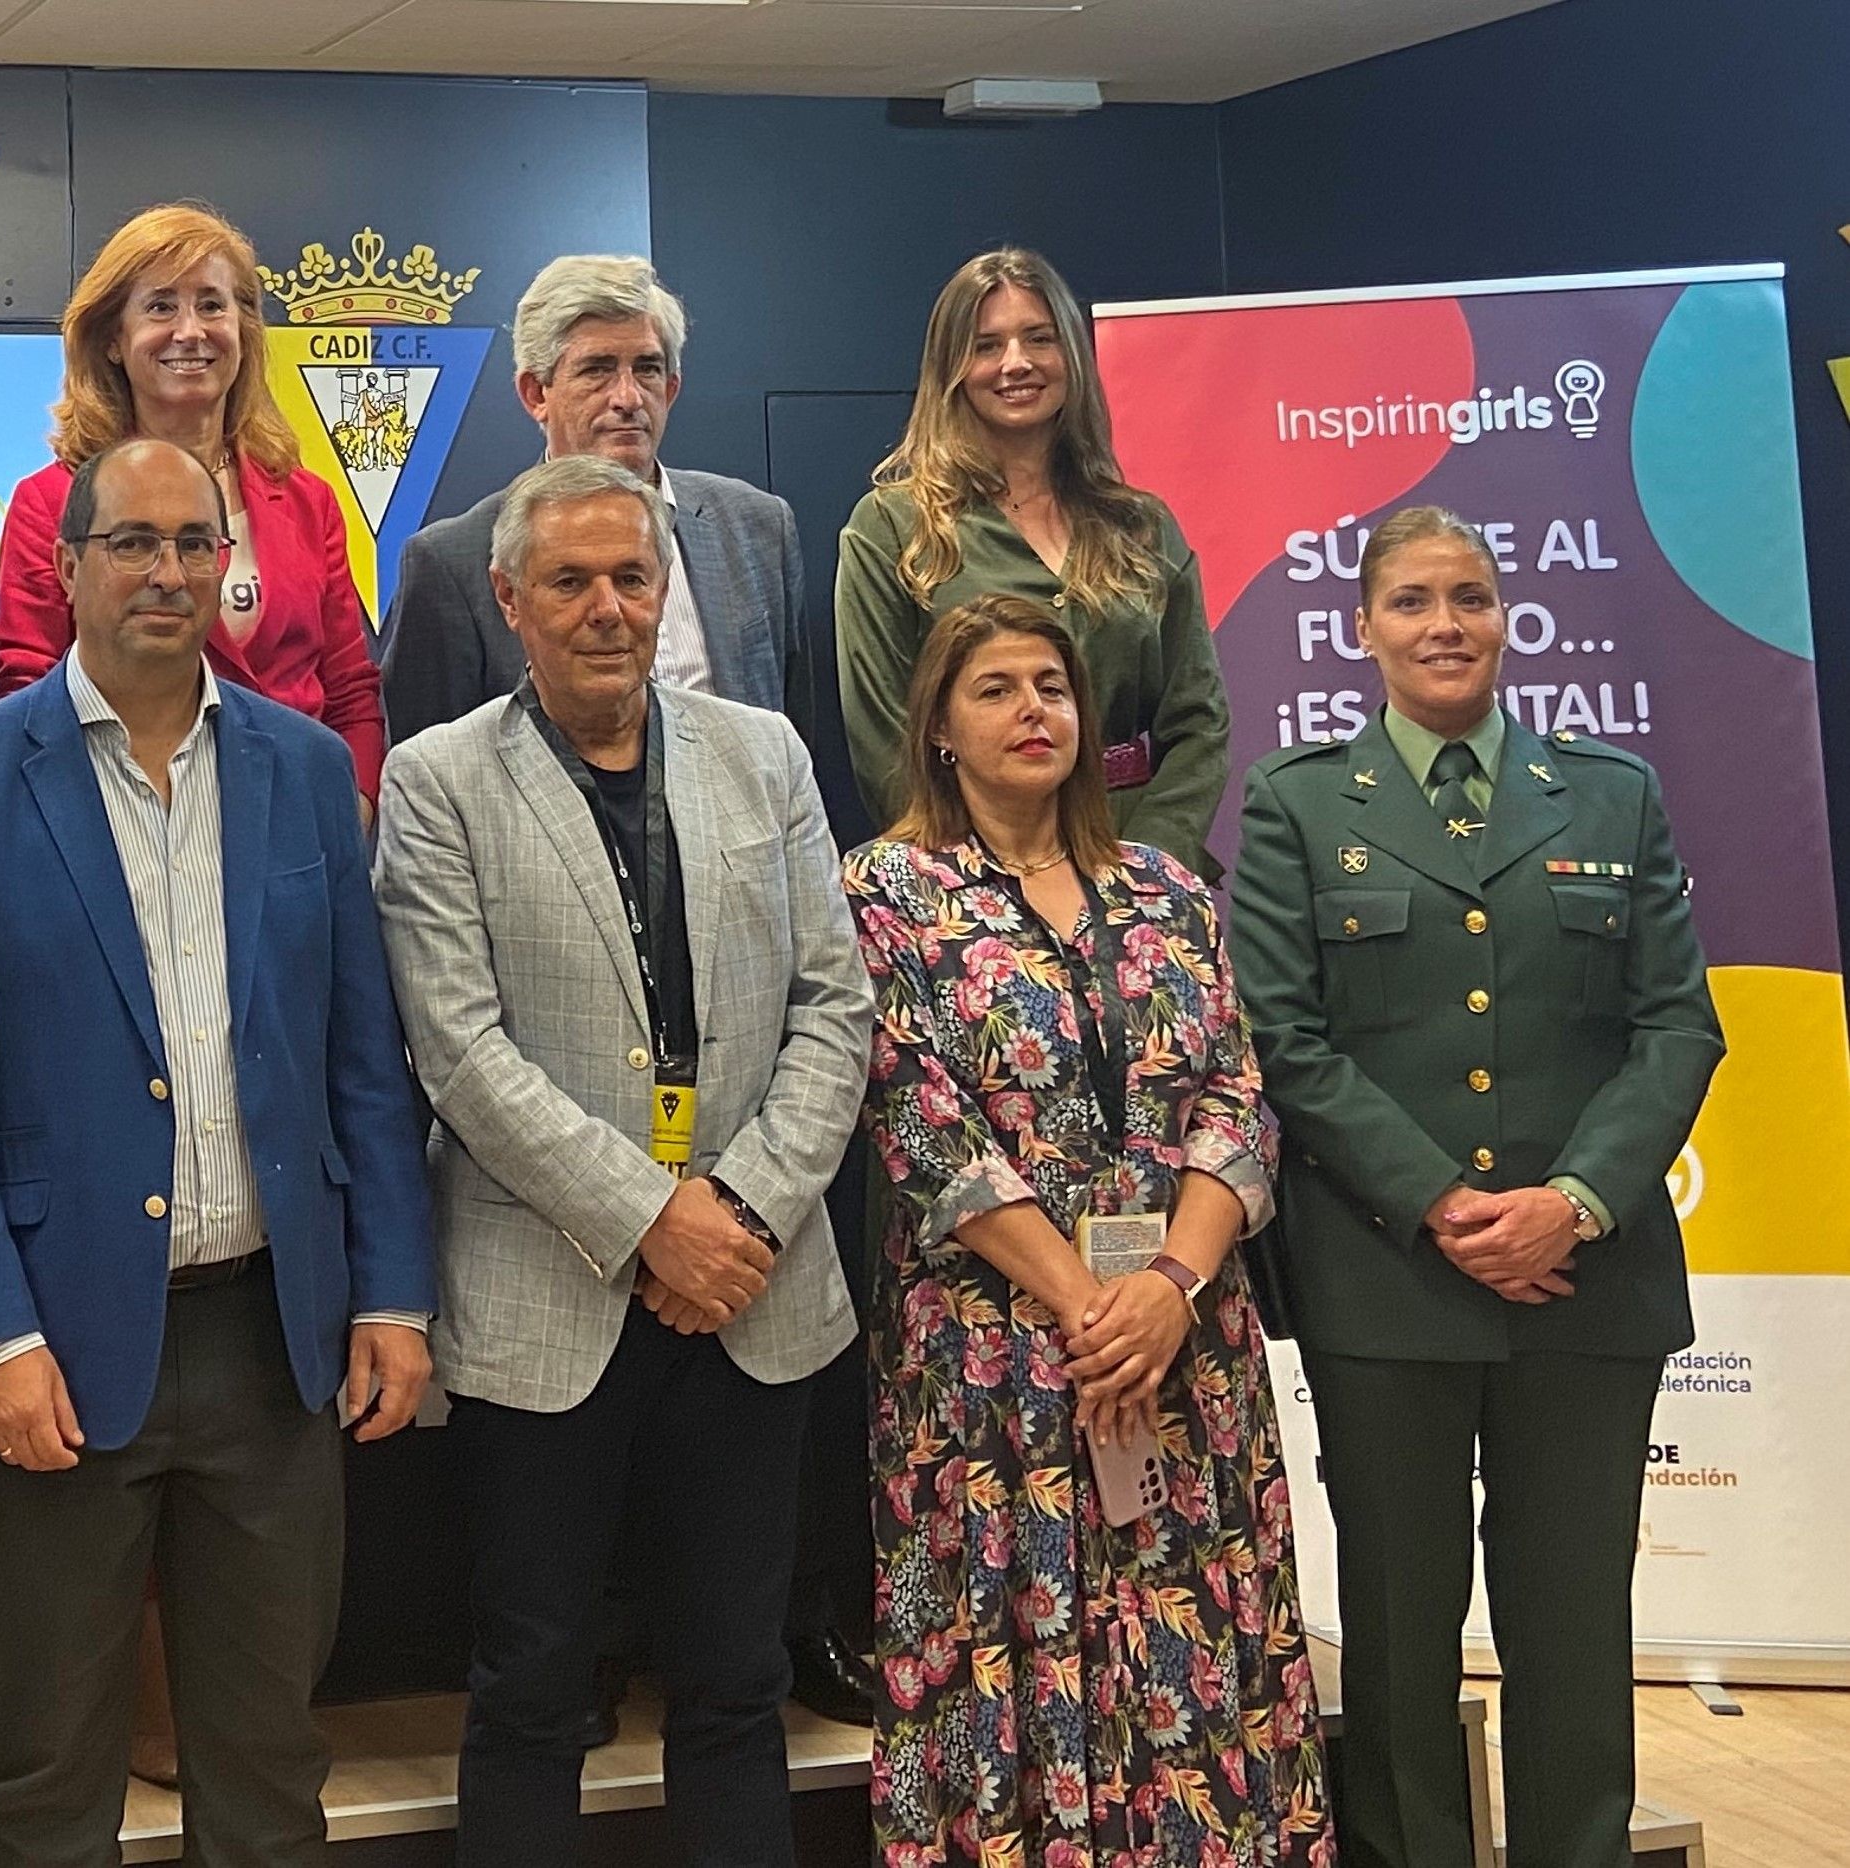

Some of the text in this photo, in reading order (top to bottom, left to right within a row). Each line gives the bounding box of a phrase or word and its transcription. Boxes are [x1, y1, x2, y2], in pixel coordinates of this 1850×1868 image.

[309, 335, 432, 359] CADIZ C.F.
[1277, 385, 1554, 449] Inspiringirls
[1537, 519, 1619, 572] AL
[1664, 1351, 1752, 1370] ndación
[1644, 1468, 1738, 1487] ndación
